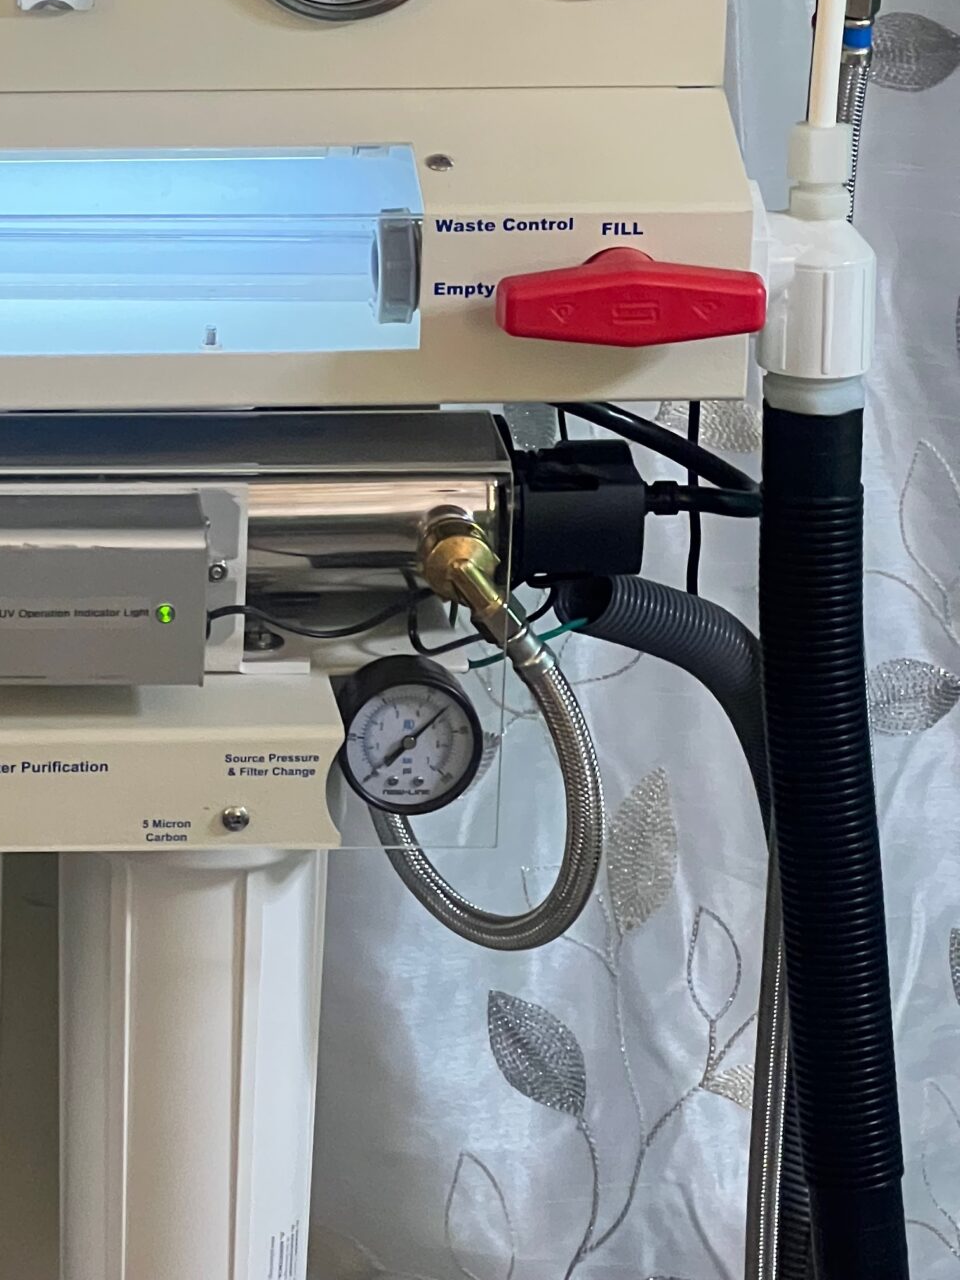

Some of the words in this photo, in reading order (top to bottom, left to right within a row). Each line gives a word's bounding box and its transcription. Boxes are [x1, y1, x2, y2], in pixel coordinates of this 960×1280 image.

[436, 219, 496, 232] Waste
[503, 217, 574, 231] Control
[602, 222, 643, 235] FILL
[434, 282, 495, 297] Empty
[0, 609, 15, 618] UV
[18, 609, 70, 619] Operation
[74, 608, 120, 617] Indicator
[124, 608, 149, 618] Light
[225, 754, 265, 763] Source
[268, 753, 319, 762] Pressure
[21, 761, 109, 773] Purification
[228, 767, 236, 776] &
[240, 767, 268, 776] Filter
[272, 767, 316, 777] Change
[143, 819, 149, 828] 5
[152, 819, 191, 828] Micron
[146, 833, 188, 841] Carbon
